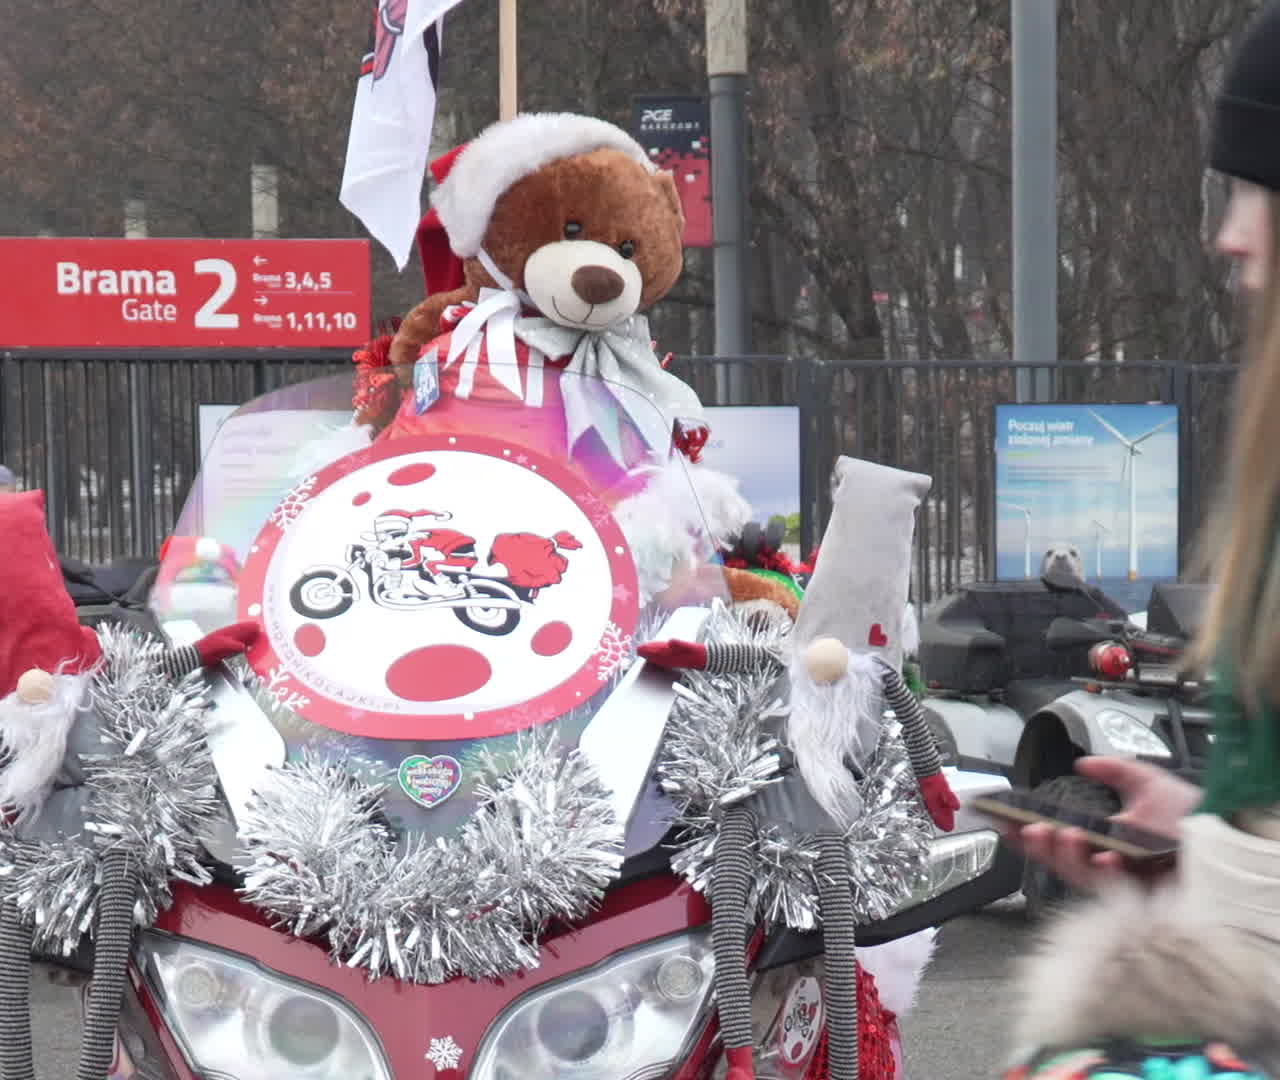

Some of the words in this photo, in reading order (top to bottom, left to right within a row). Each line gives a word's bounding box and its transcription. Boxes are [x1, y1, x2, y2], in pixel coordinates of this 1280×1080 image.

[285, 271, 332, 292] 3,4,5
[56, 261, 177, 296] Brama
[194, 258, 240, 329] 2
[121, 298, 177, 322] Gate
[286, 311, 357, 332] 1,11,10
